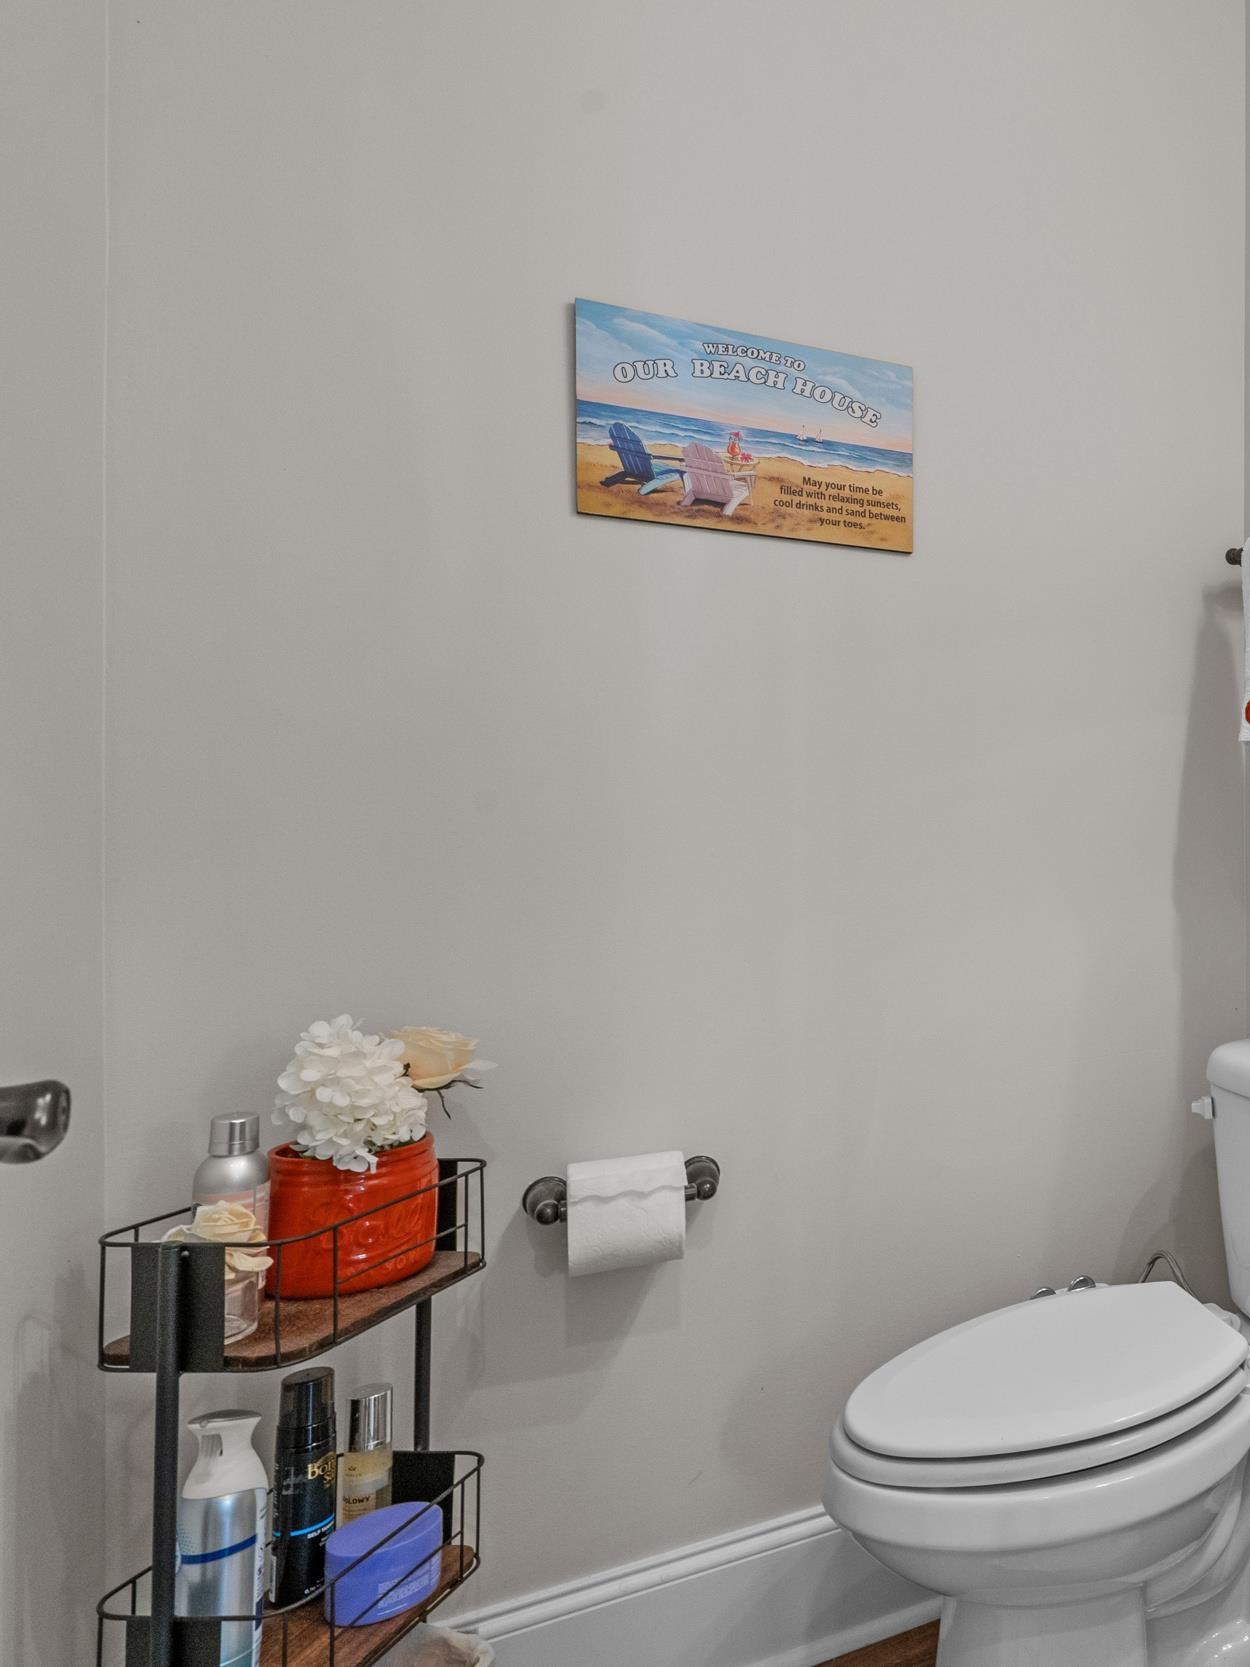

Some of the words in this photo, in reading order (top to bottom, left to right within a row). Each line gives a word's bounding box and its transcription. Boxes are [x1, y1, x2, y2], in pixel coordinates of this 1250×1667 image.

[703, 342, 781, 365] WELCOME
[783, 355, 806, 372] TO
[612, 358, 679, 384] OUR
[691, 358, 788, 390] BEACH
[791, 376, 882, 428] HOUSE
[779, 485, 804, 497] filled
[805, 489, 827, 501] with
[828, 493, 865, 508] relaxing
[866, 499, 902, 512] sunsets,
[802, 476, 823, 490] May
[824, 481, 847, 492] your
[848, 483, 870, 495] time
[871, 486, 884, 497] be
[773, 498, 794, 508] cool
[795, 500, 825, 513] drinks
[826, 505, 844, 515] and
[845, 508, 867, 518] sand
[868, 510, 907, 524] between
[819, 517, 842, 528] your
[843, 519, 866, 530] toes.
